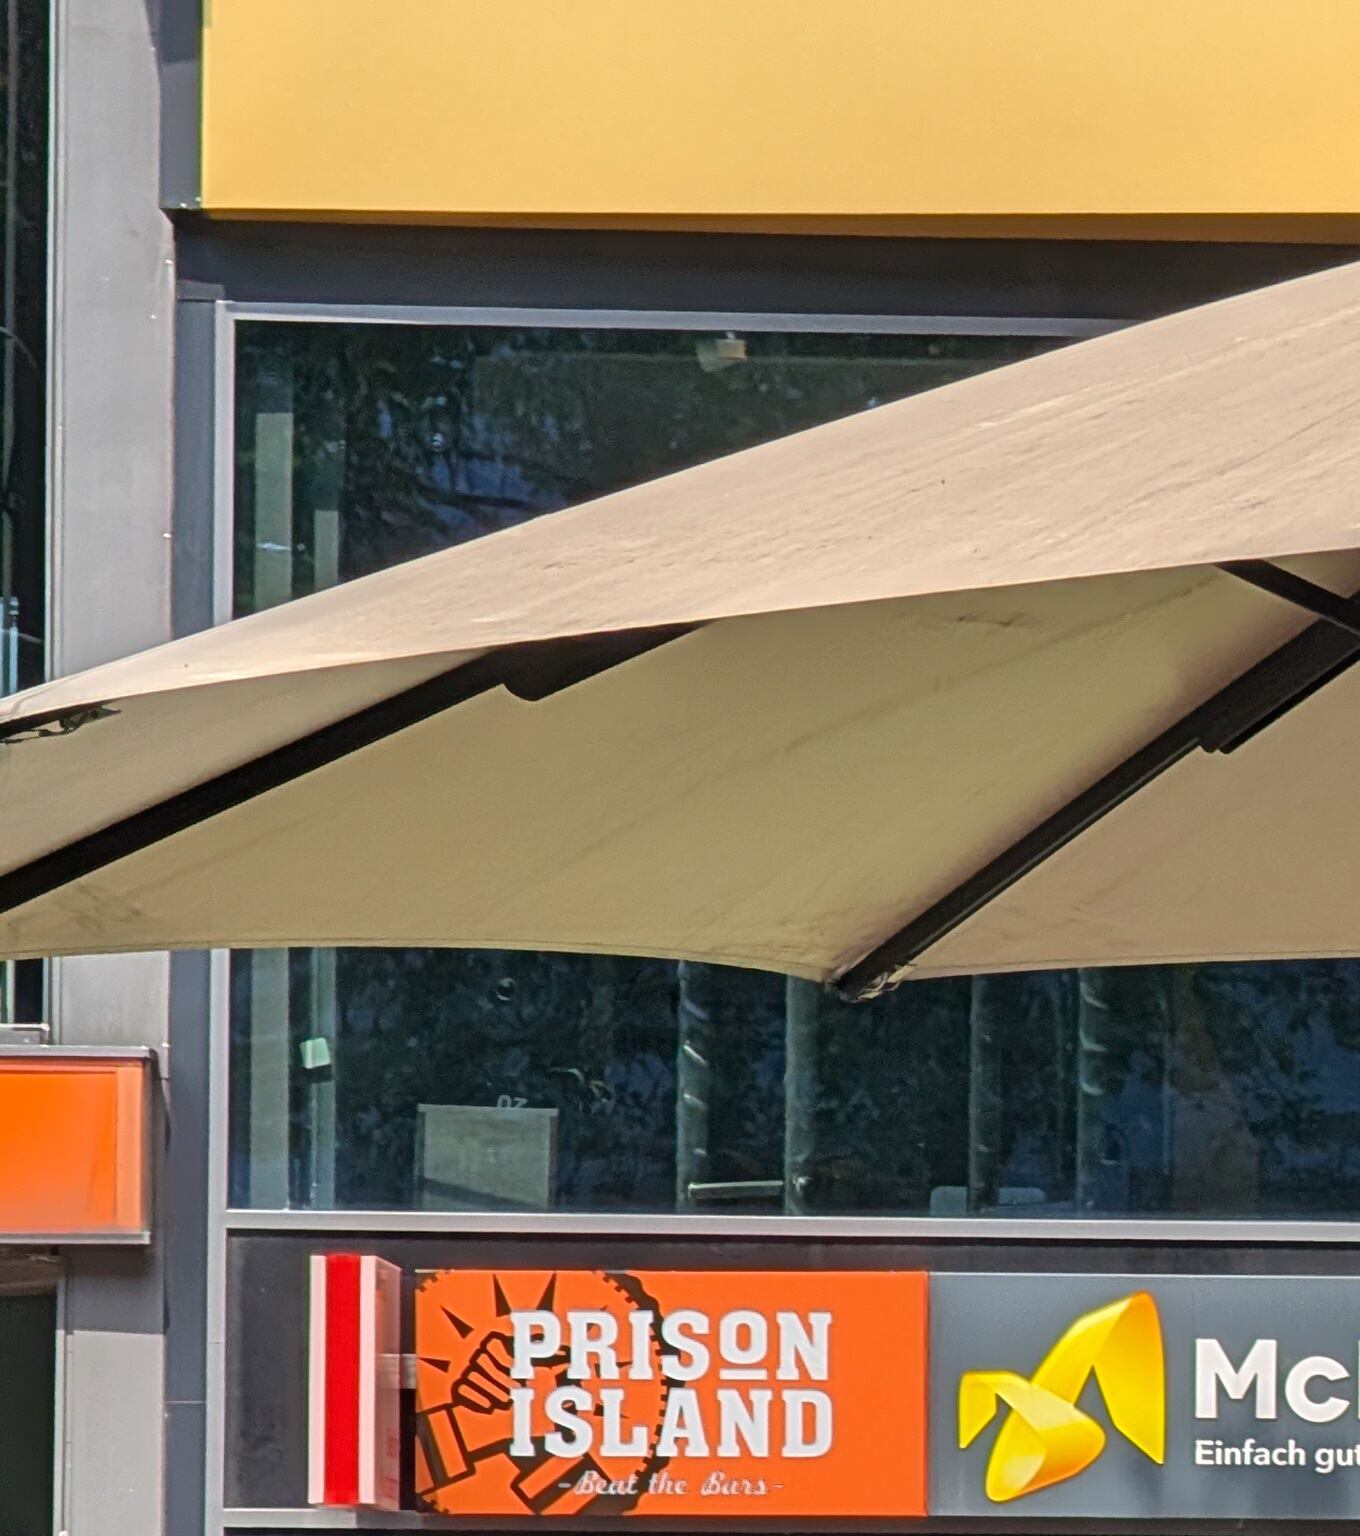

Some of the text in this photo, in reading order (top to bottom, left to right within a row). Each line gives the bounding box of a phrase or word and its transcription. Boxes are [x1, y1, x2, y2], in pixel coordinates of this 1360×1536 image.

[510, 1310, 832, 1381] PRISON
[509, 1387, 834, 1458] ISLAND
[1194, 1438, 1306, 1467] Einfach
[647, 1469, 688, 1496] the
